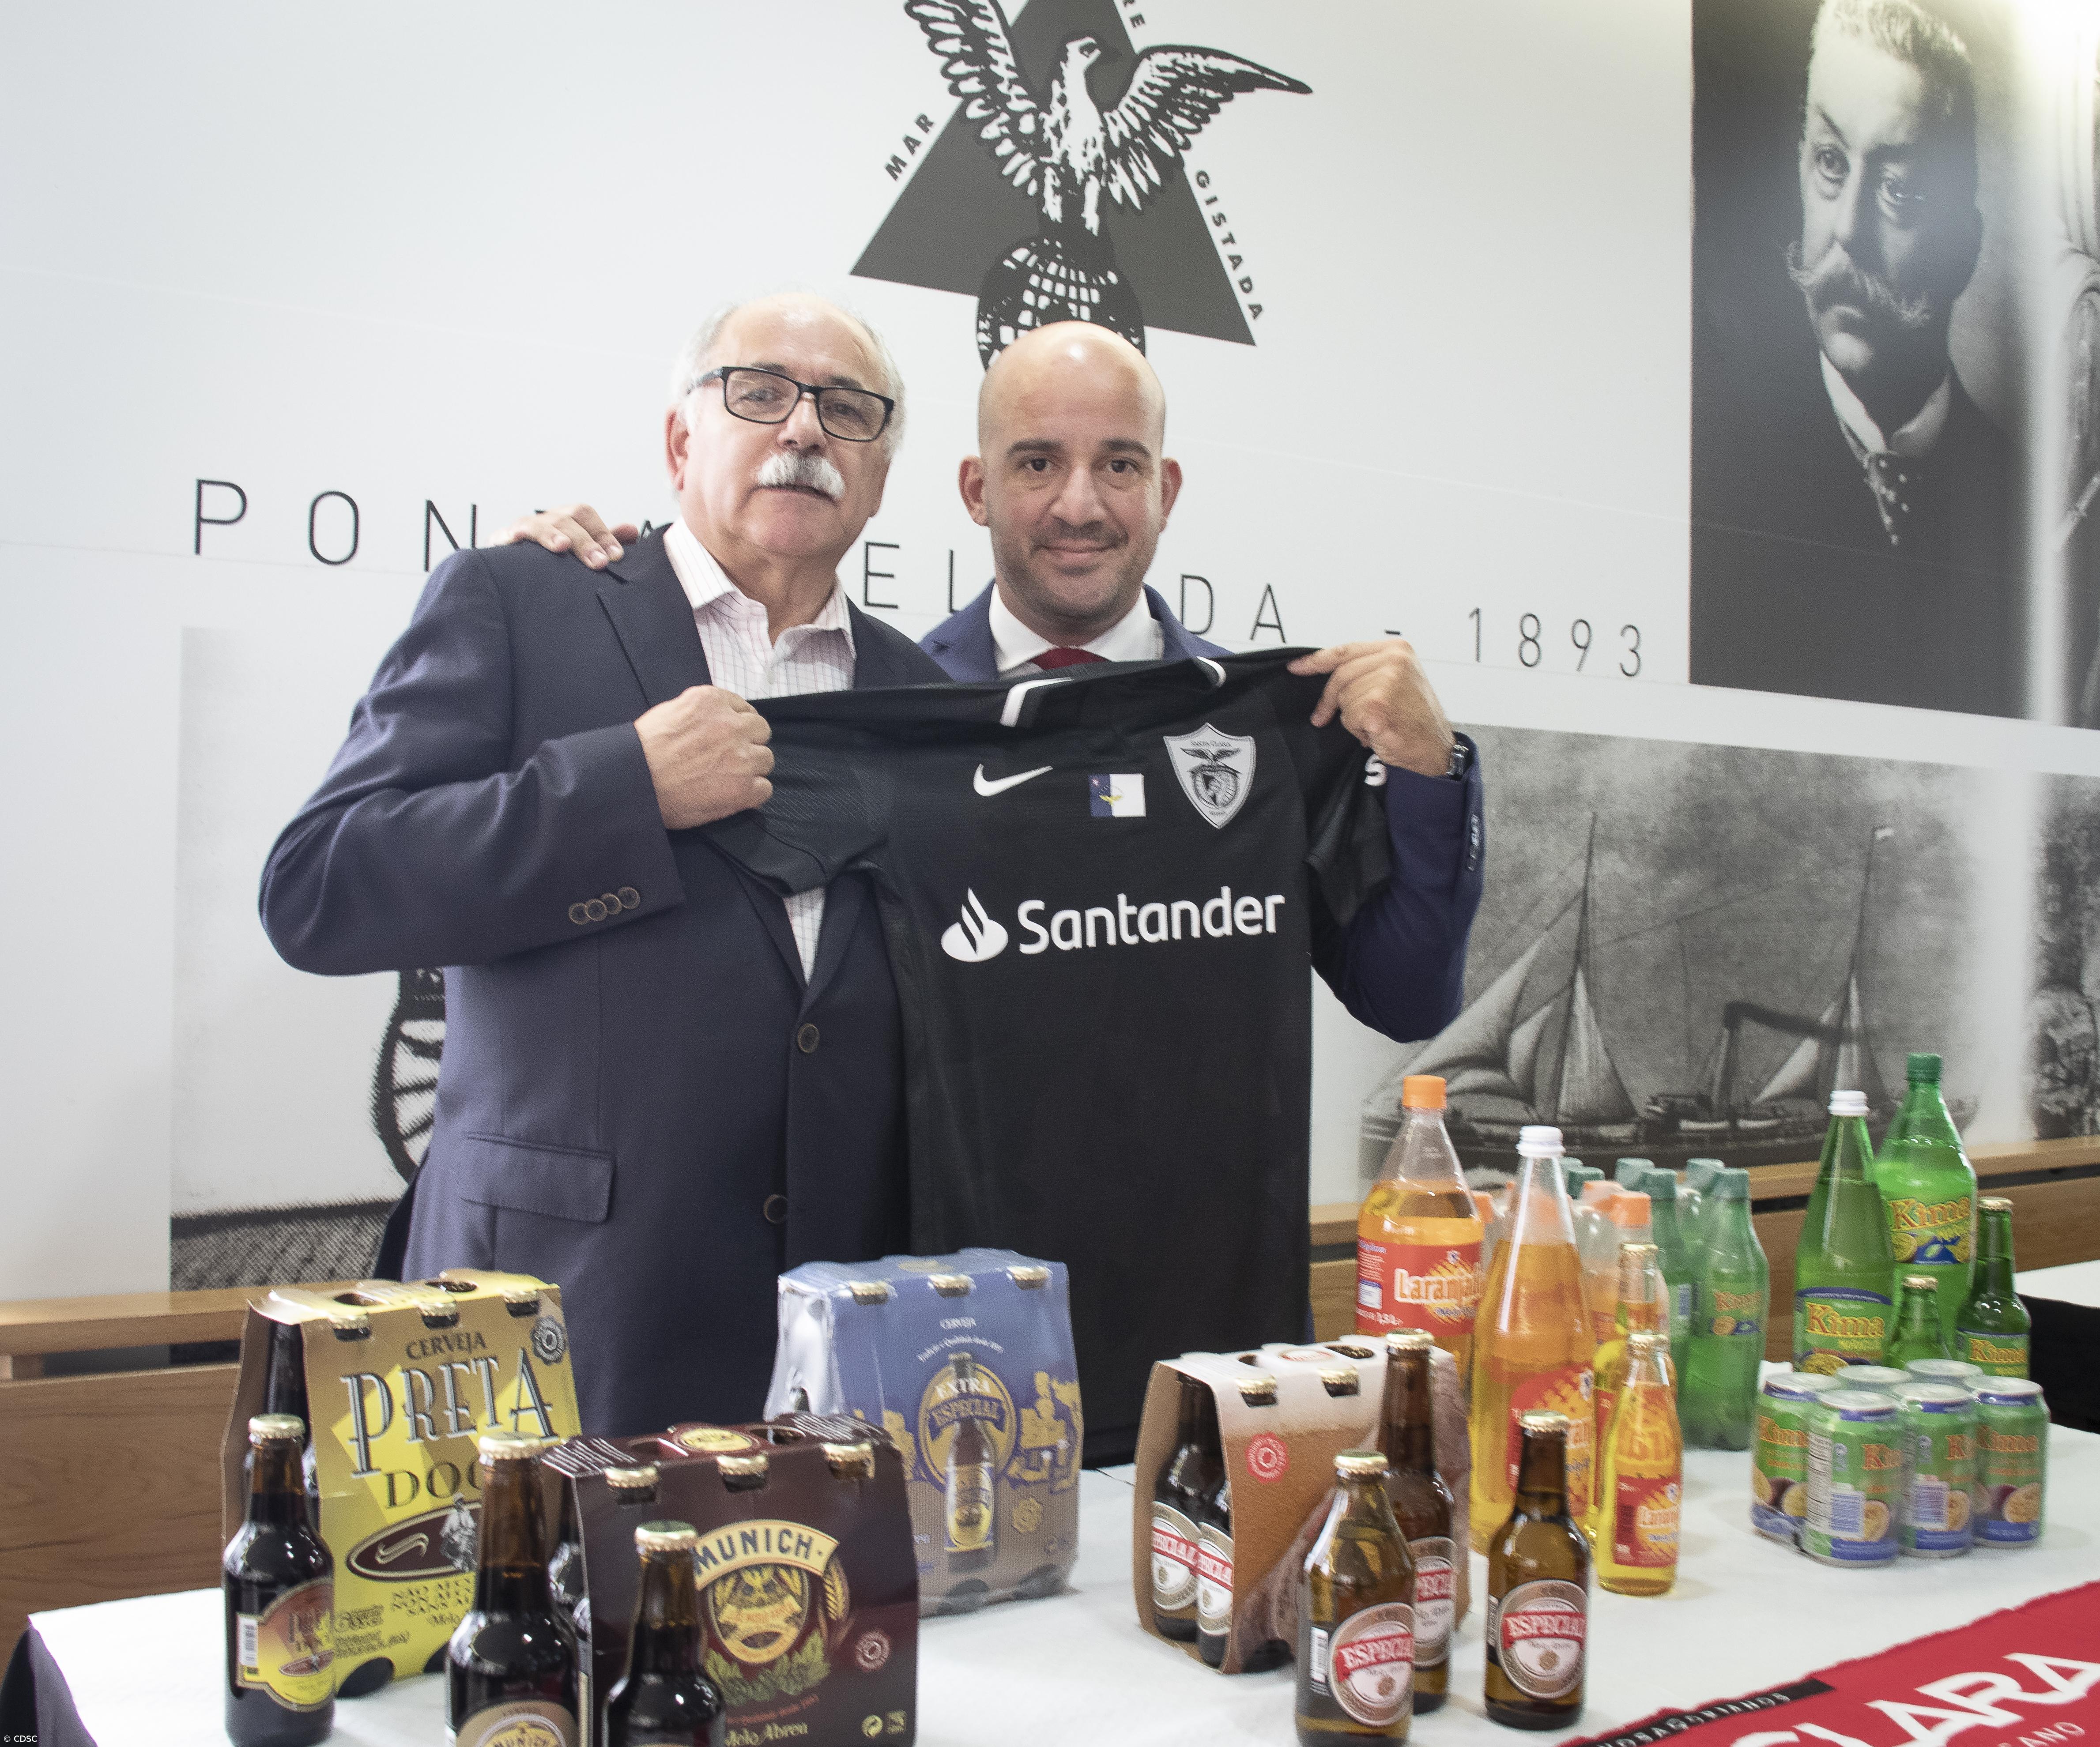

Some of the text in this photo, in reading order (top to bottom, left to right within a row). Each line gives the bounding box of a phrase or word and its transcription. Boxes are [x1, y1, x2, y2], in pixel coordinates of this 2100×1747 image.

[1195, 169, 1265, 321] GISTADA
[1469, 606, 1642, 678] 1893
[1018, 886, 1285, 955] Santander
[1888, 1196, 1971, 1231] Kima
[1805, 1301, 1885, 1338] Kima
[405, 1331, 488, 1360] CERVEJA
[1968, 1338, 2028, 1364] Kima
[935, 1377, 992, 1399] EXTRA
[339, 1347, 560, 1479] PRETA
[931, 1398, 1000, 1427] ESPECIAL
[1759, 1415, 1809, 1448] Kim
[691, 1528, 813, 1577] MUNICH
[1339, 1635, 1413, 1669] ESPECIA
